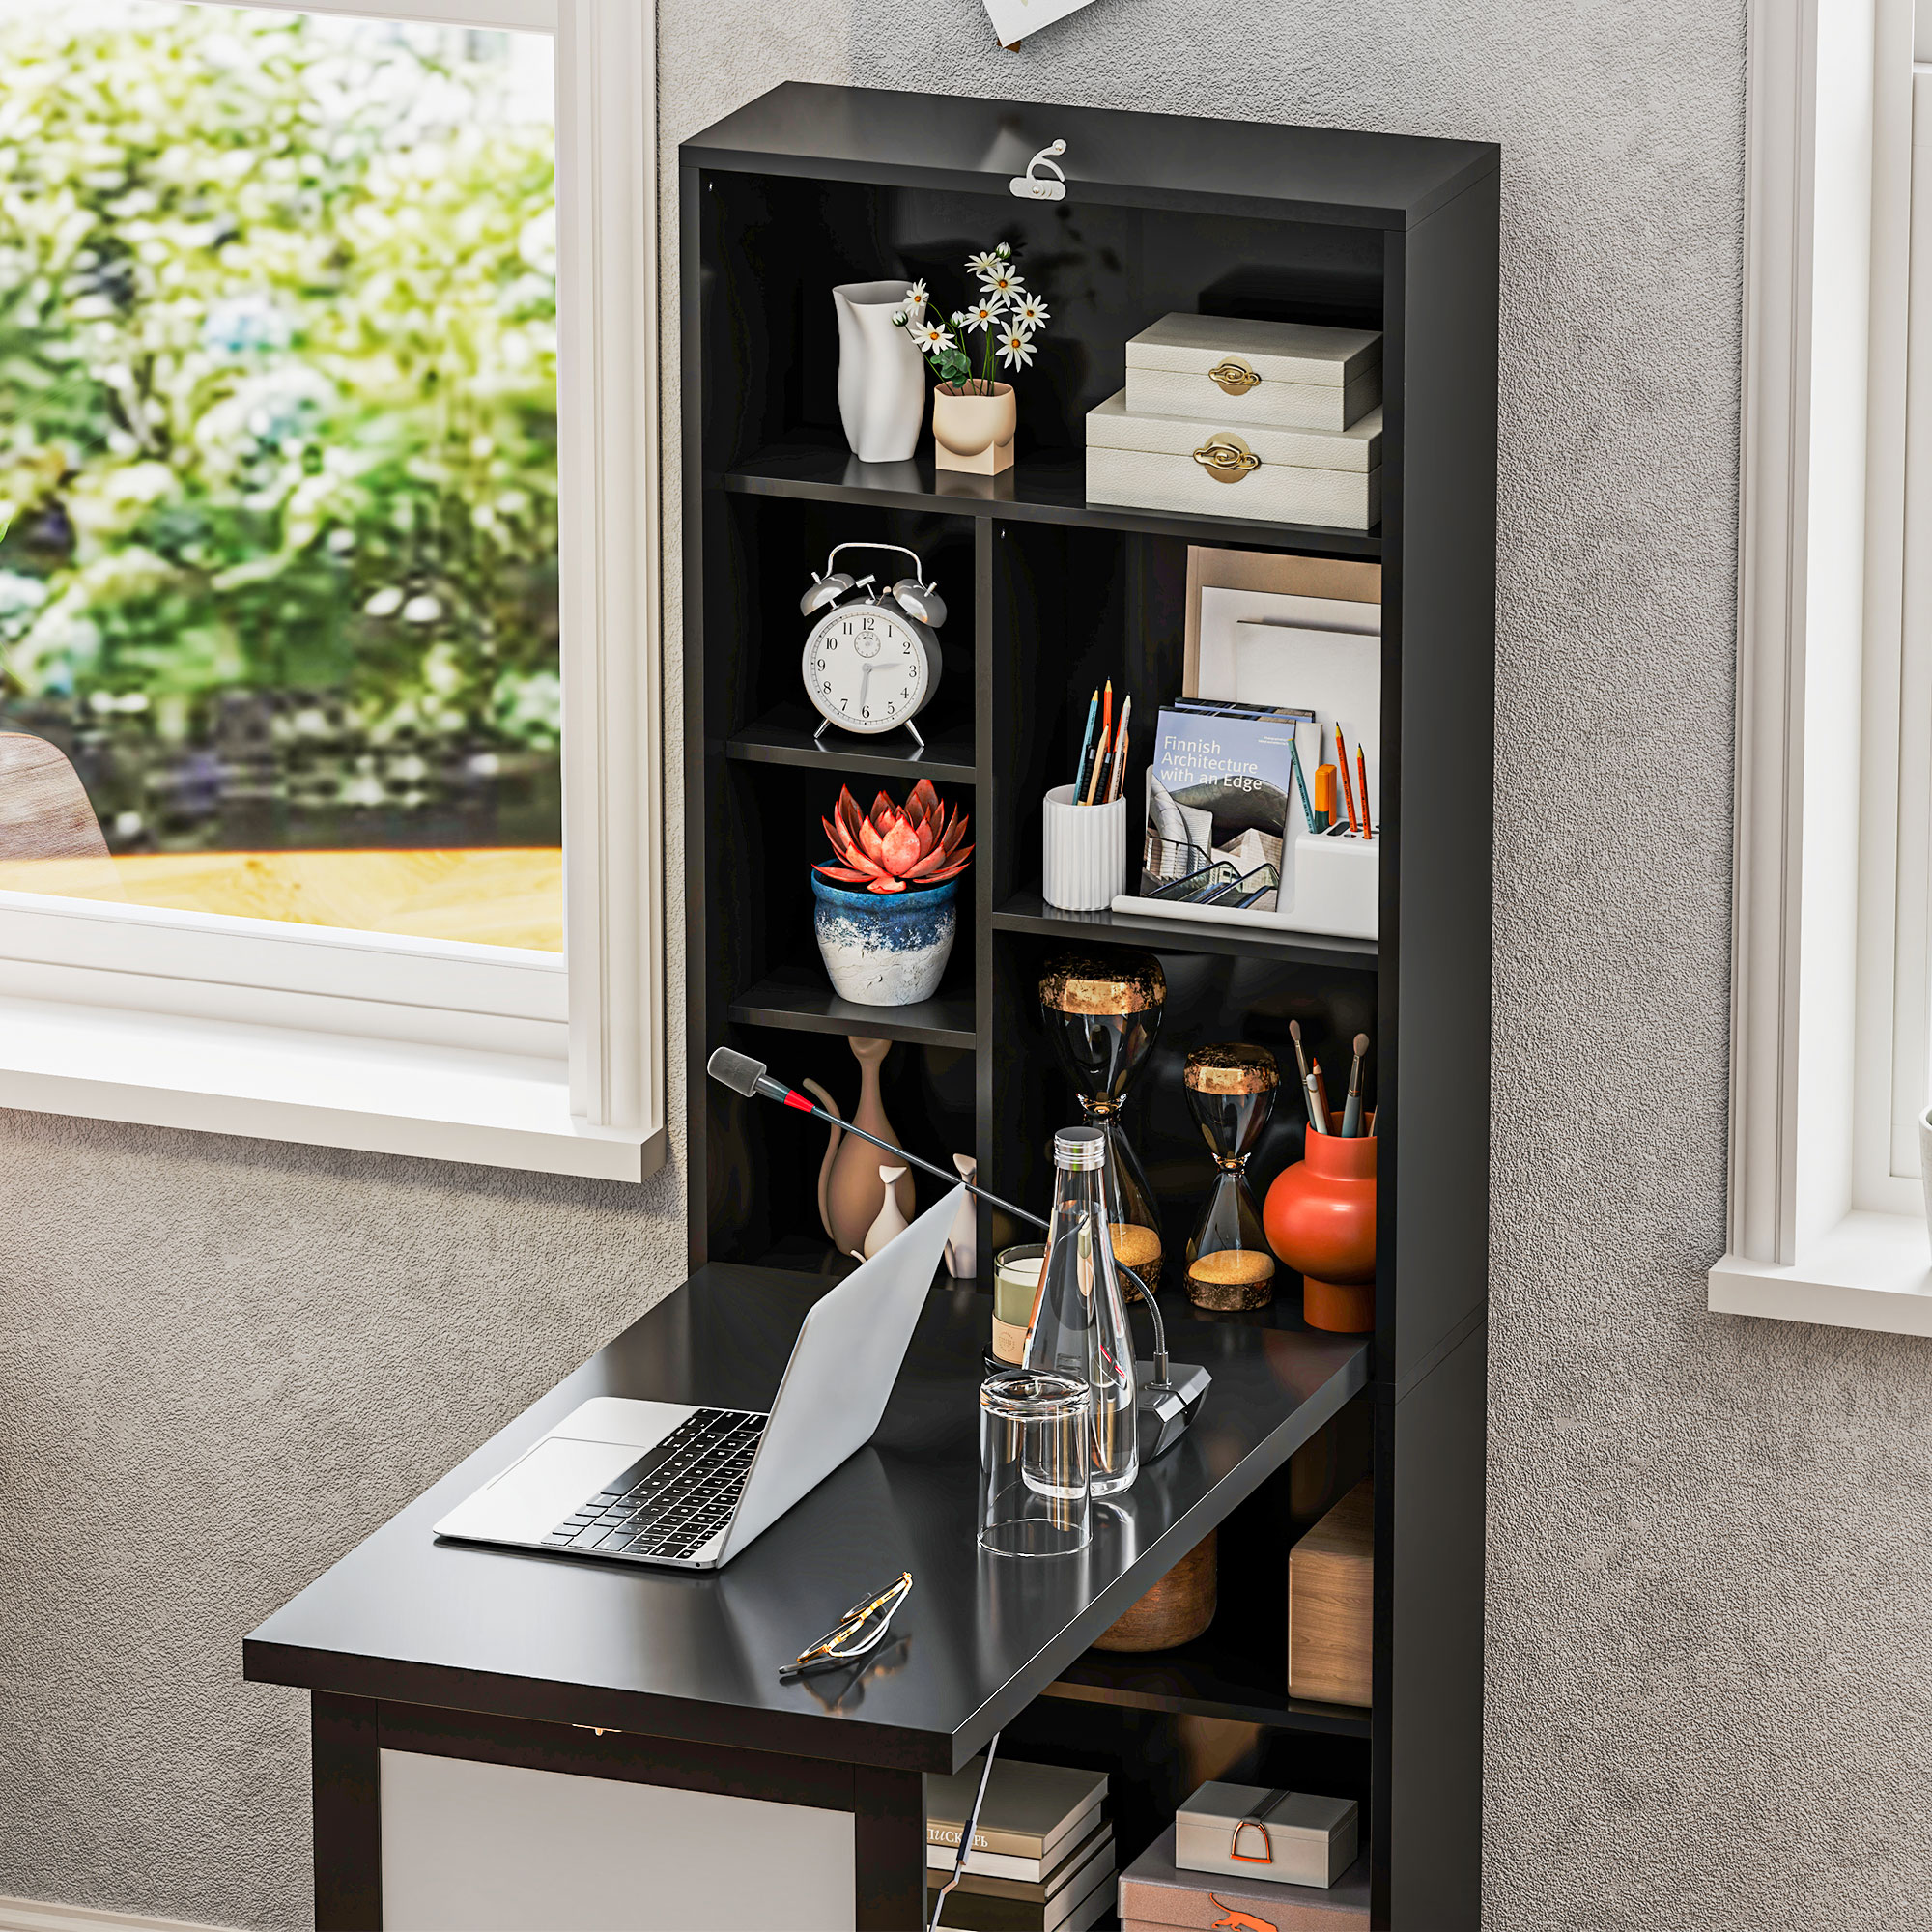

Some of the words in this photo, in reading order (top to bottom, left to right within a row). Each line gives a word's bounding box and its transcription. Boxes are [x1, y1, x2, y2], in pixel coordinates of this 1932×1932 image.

[843, 622, 853, 635] 11
[863, 618, 875, 631] 12
[888, 625, 893, 638] 1
[826, 638, 838, 650] 10
[902, 642, 911, 655] 2
[817, 659, 826, 671] 9
[909, 666, 917, 678] 3
[823, 681, 832, 694] 8
[900, 687, 909, 699] 4
[840, 698, 848, 712] 7
[887, 701, 895, 715] 5
[862, 705, 869, 719] 6
[1163, 735, 1221, 755] Finnish
[1161, 752, 1258, 774] Architecture
[1160, 768, 1194, 783] with
[1199, 774, 1218, 785] an
[1223, 773, 1263, 792] Edge
